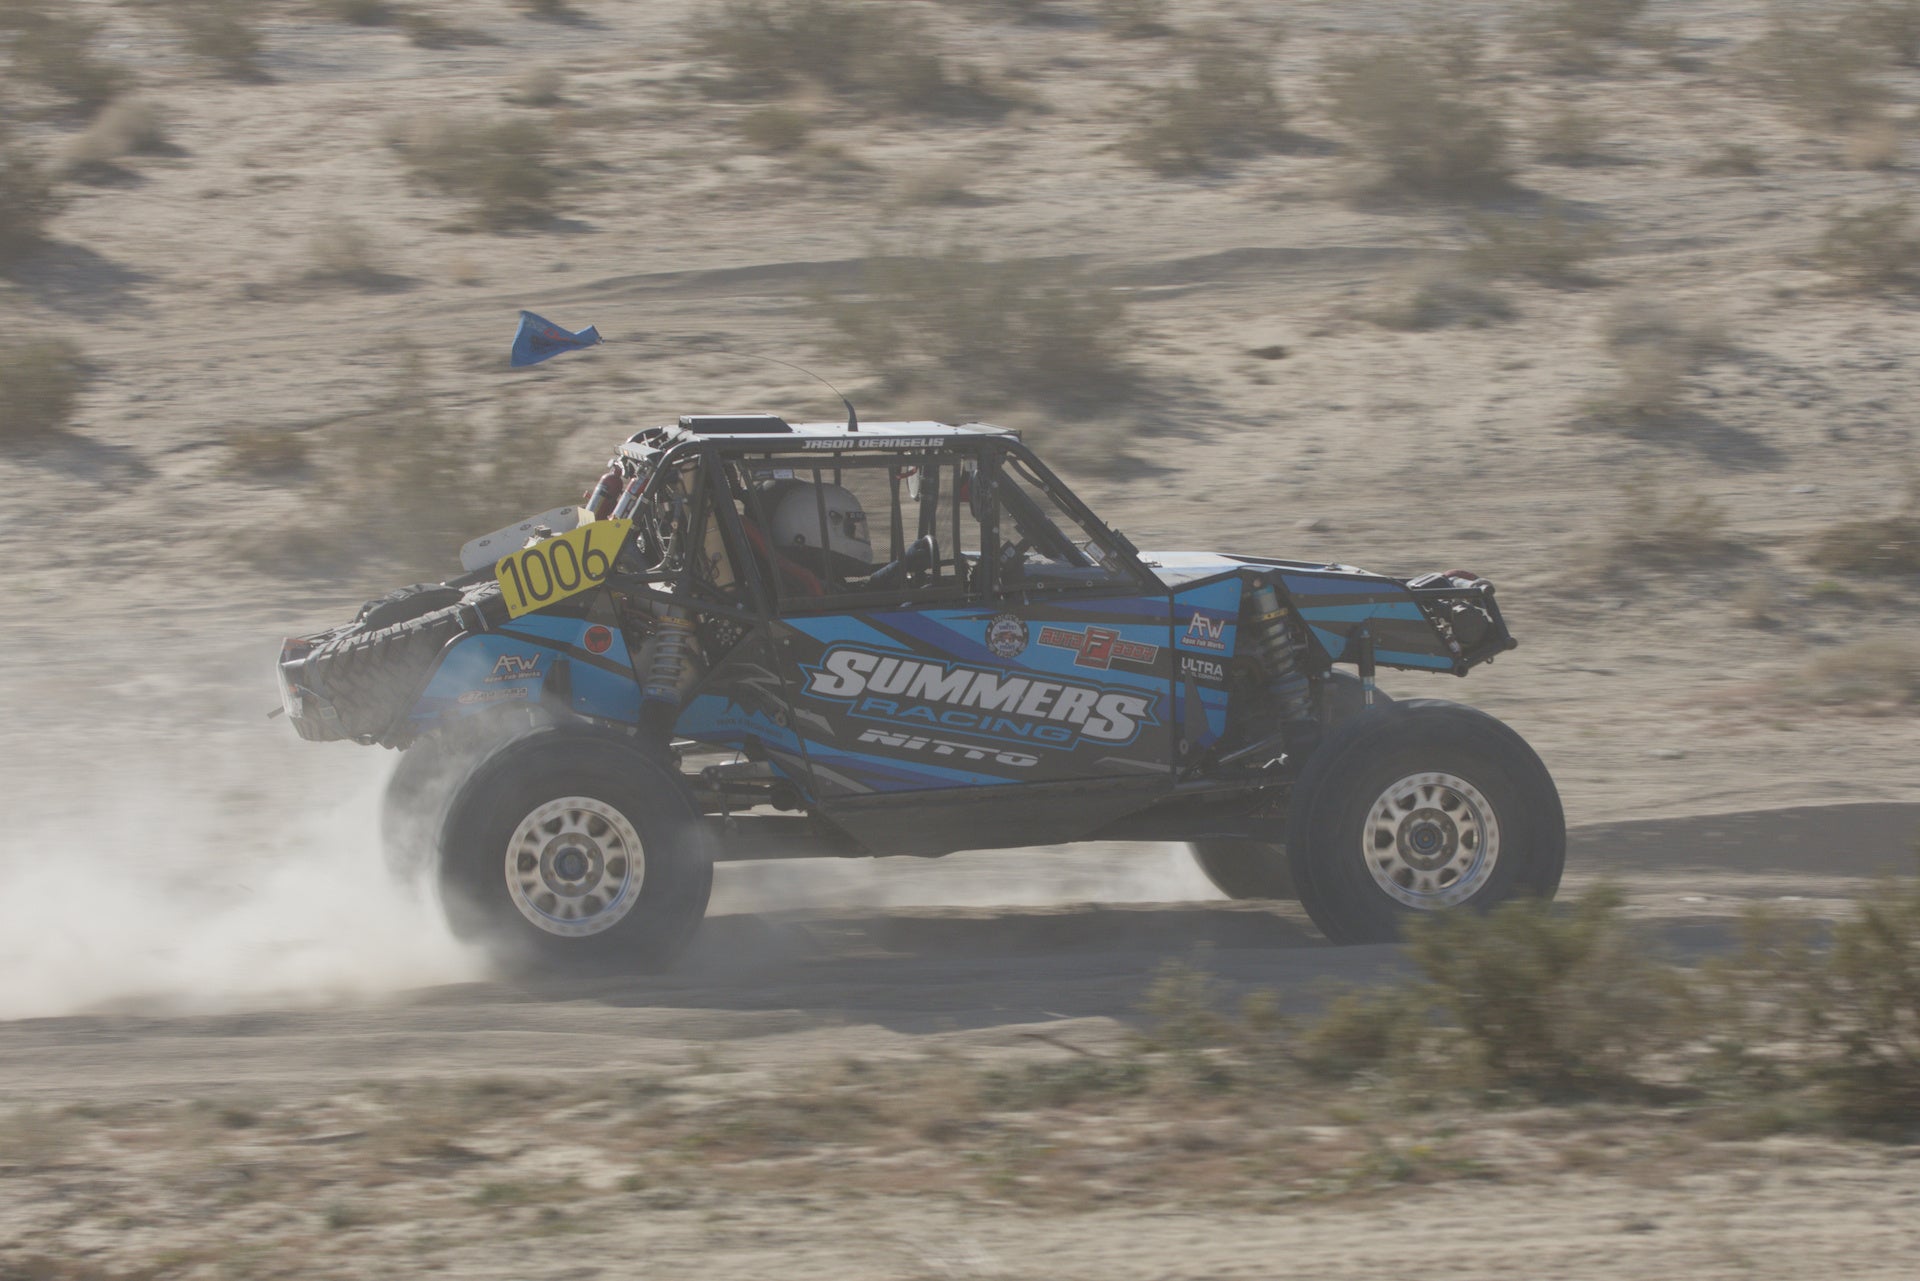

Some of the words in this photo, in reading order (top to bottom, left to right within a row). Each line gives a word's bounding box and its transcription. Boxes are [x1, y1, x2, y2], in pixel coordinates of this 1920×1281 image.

[802, 439, 854, 449] JASON
[858, 438, 945, 448] DEANGELIS
[500, 529, 610, 607] 1006
[1188, 612, 1225, 638] AFW
[492, 653, 541, 674] AFW
[1181, 656, 1223, 676] ULTRA
[811, 650, 1150, 740] SUMMERS
[860, 697, 1073, 742] RACING
[857, 729, 1040, 767] NITTO
